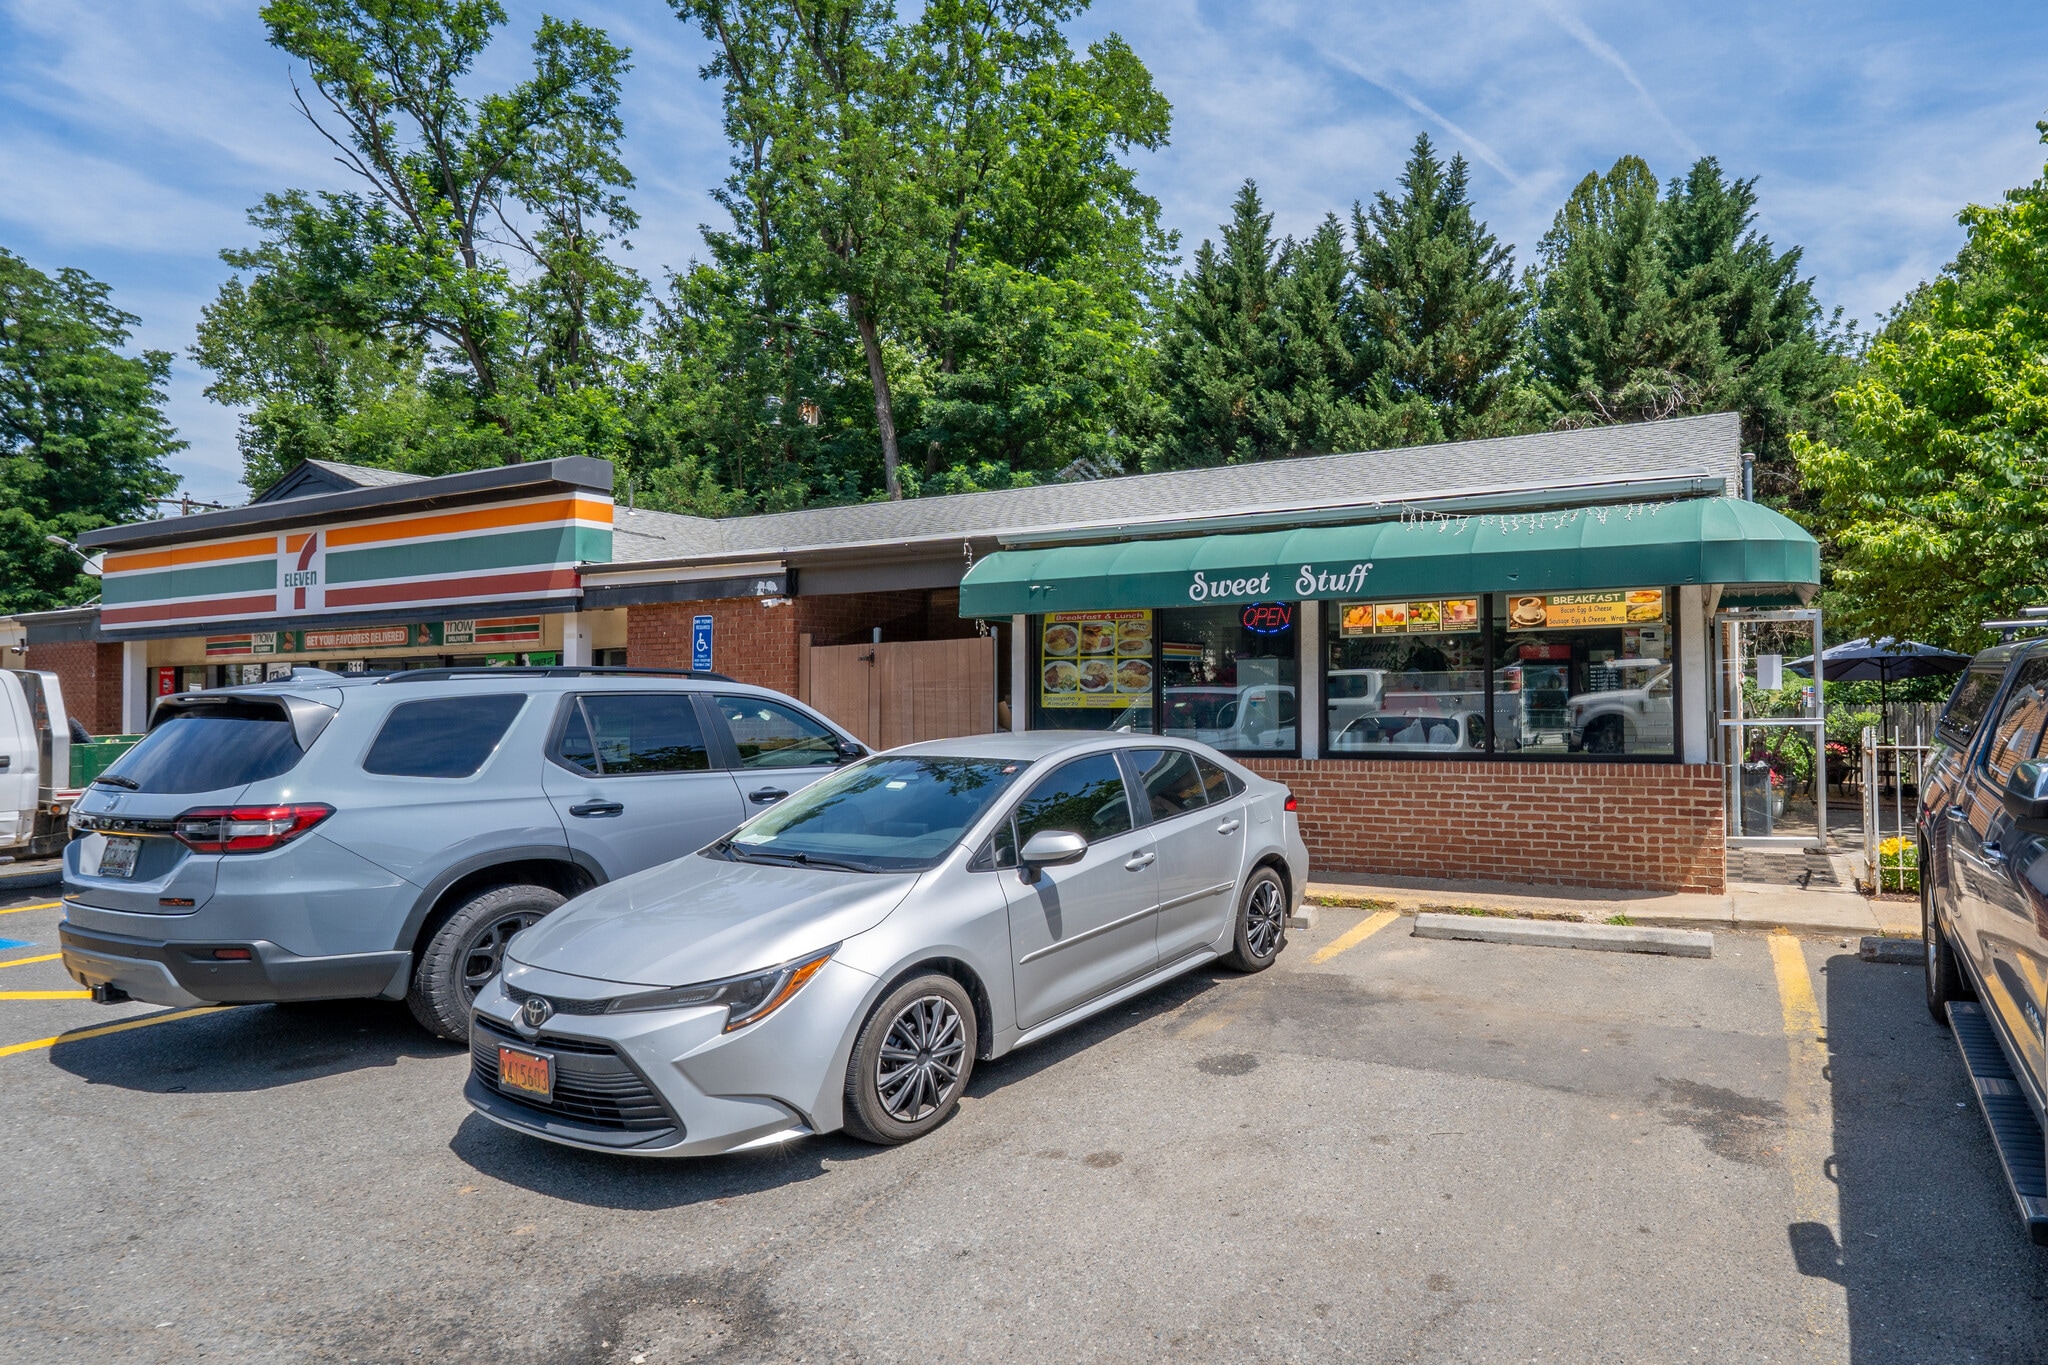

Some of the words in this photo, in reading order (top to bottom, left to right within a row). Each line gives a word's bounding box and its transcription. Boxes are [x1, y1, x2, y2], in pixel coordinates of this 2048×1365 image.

[1189, 571, 1270, 601] Sweet
[1295, 563, 1373, 596] Stuff
[1553, 593, 1621, 605] BREAKFAST
[1577, 606, 1586, 614] Egg
[1055, 613, 1102, 621] Breakfast
[1243, 607, 1292, 626] OPEN
[1571, 616, 1580, 625] Egg
[306, 635, 318, 646] GET
[319, 635, 335, 645] YOUR
[335, 633, 369, 644] FAVORITES
[370, 631, 404, 643] DELIVERED
